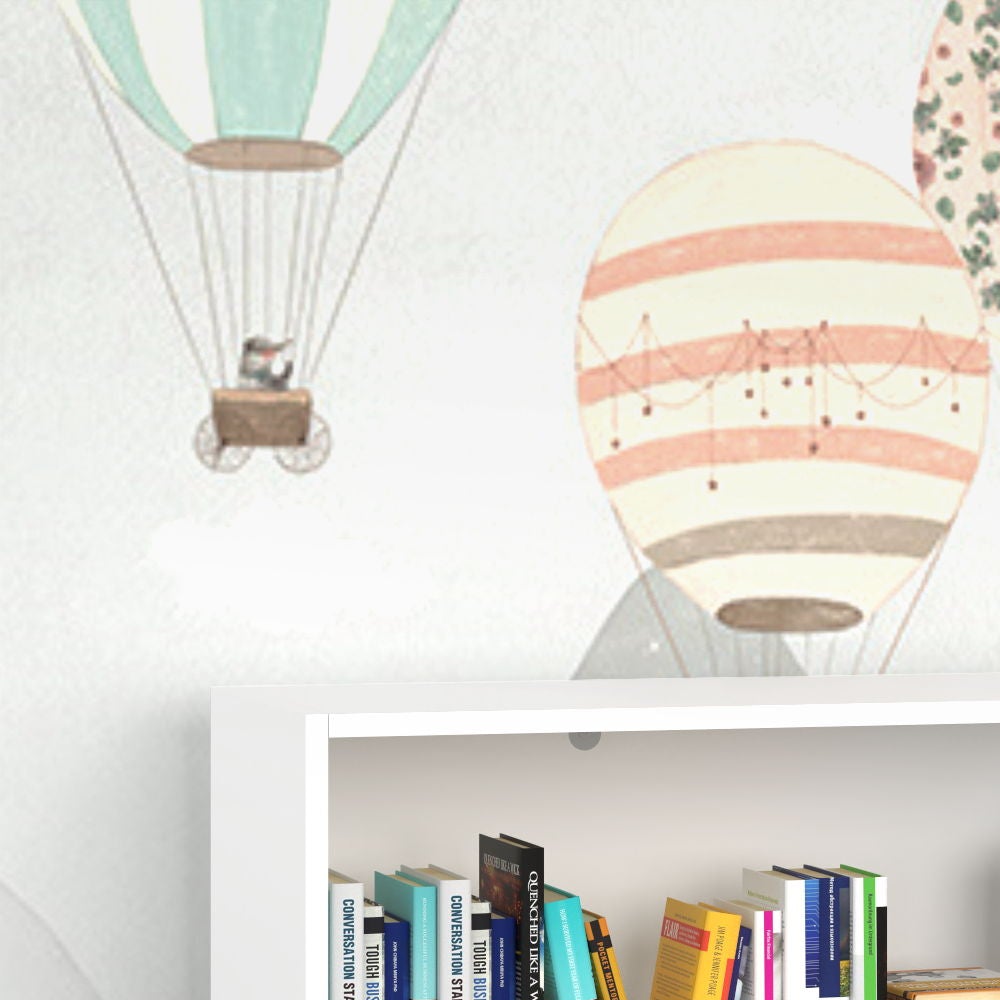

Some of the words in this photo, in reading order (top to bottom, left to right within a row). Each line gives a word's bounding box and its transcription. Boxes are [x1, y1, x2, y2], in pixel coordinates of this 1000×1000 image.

[528, 871, 539, 945] QUENCHED
[343, 899, 355, 980] CONVERSATION
[451, 896, 463, 975] CONVERSATION
[663, 919, 680, 940] FLAIR
[366, 944, 379, 979] TOUGH
[473, 940, 487, 974] TOUGH
[529, 948, 539, 976] LIKE
[596, 941, 610, 970] POCKET
[529, 978, 538, 987] A
